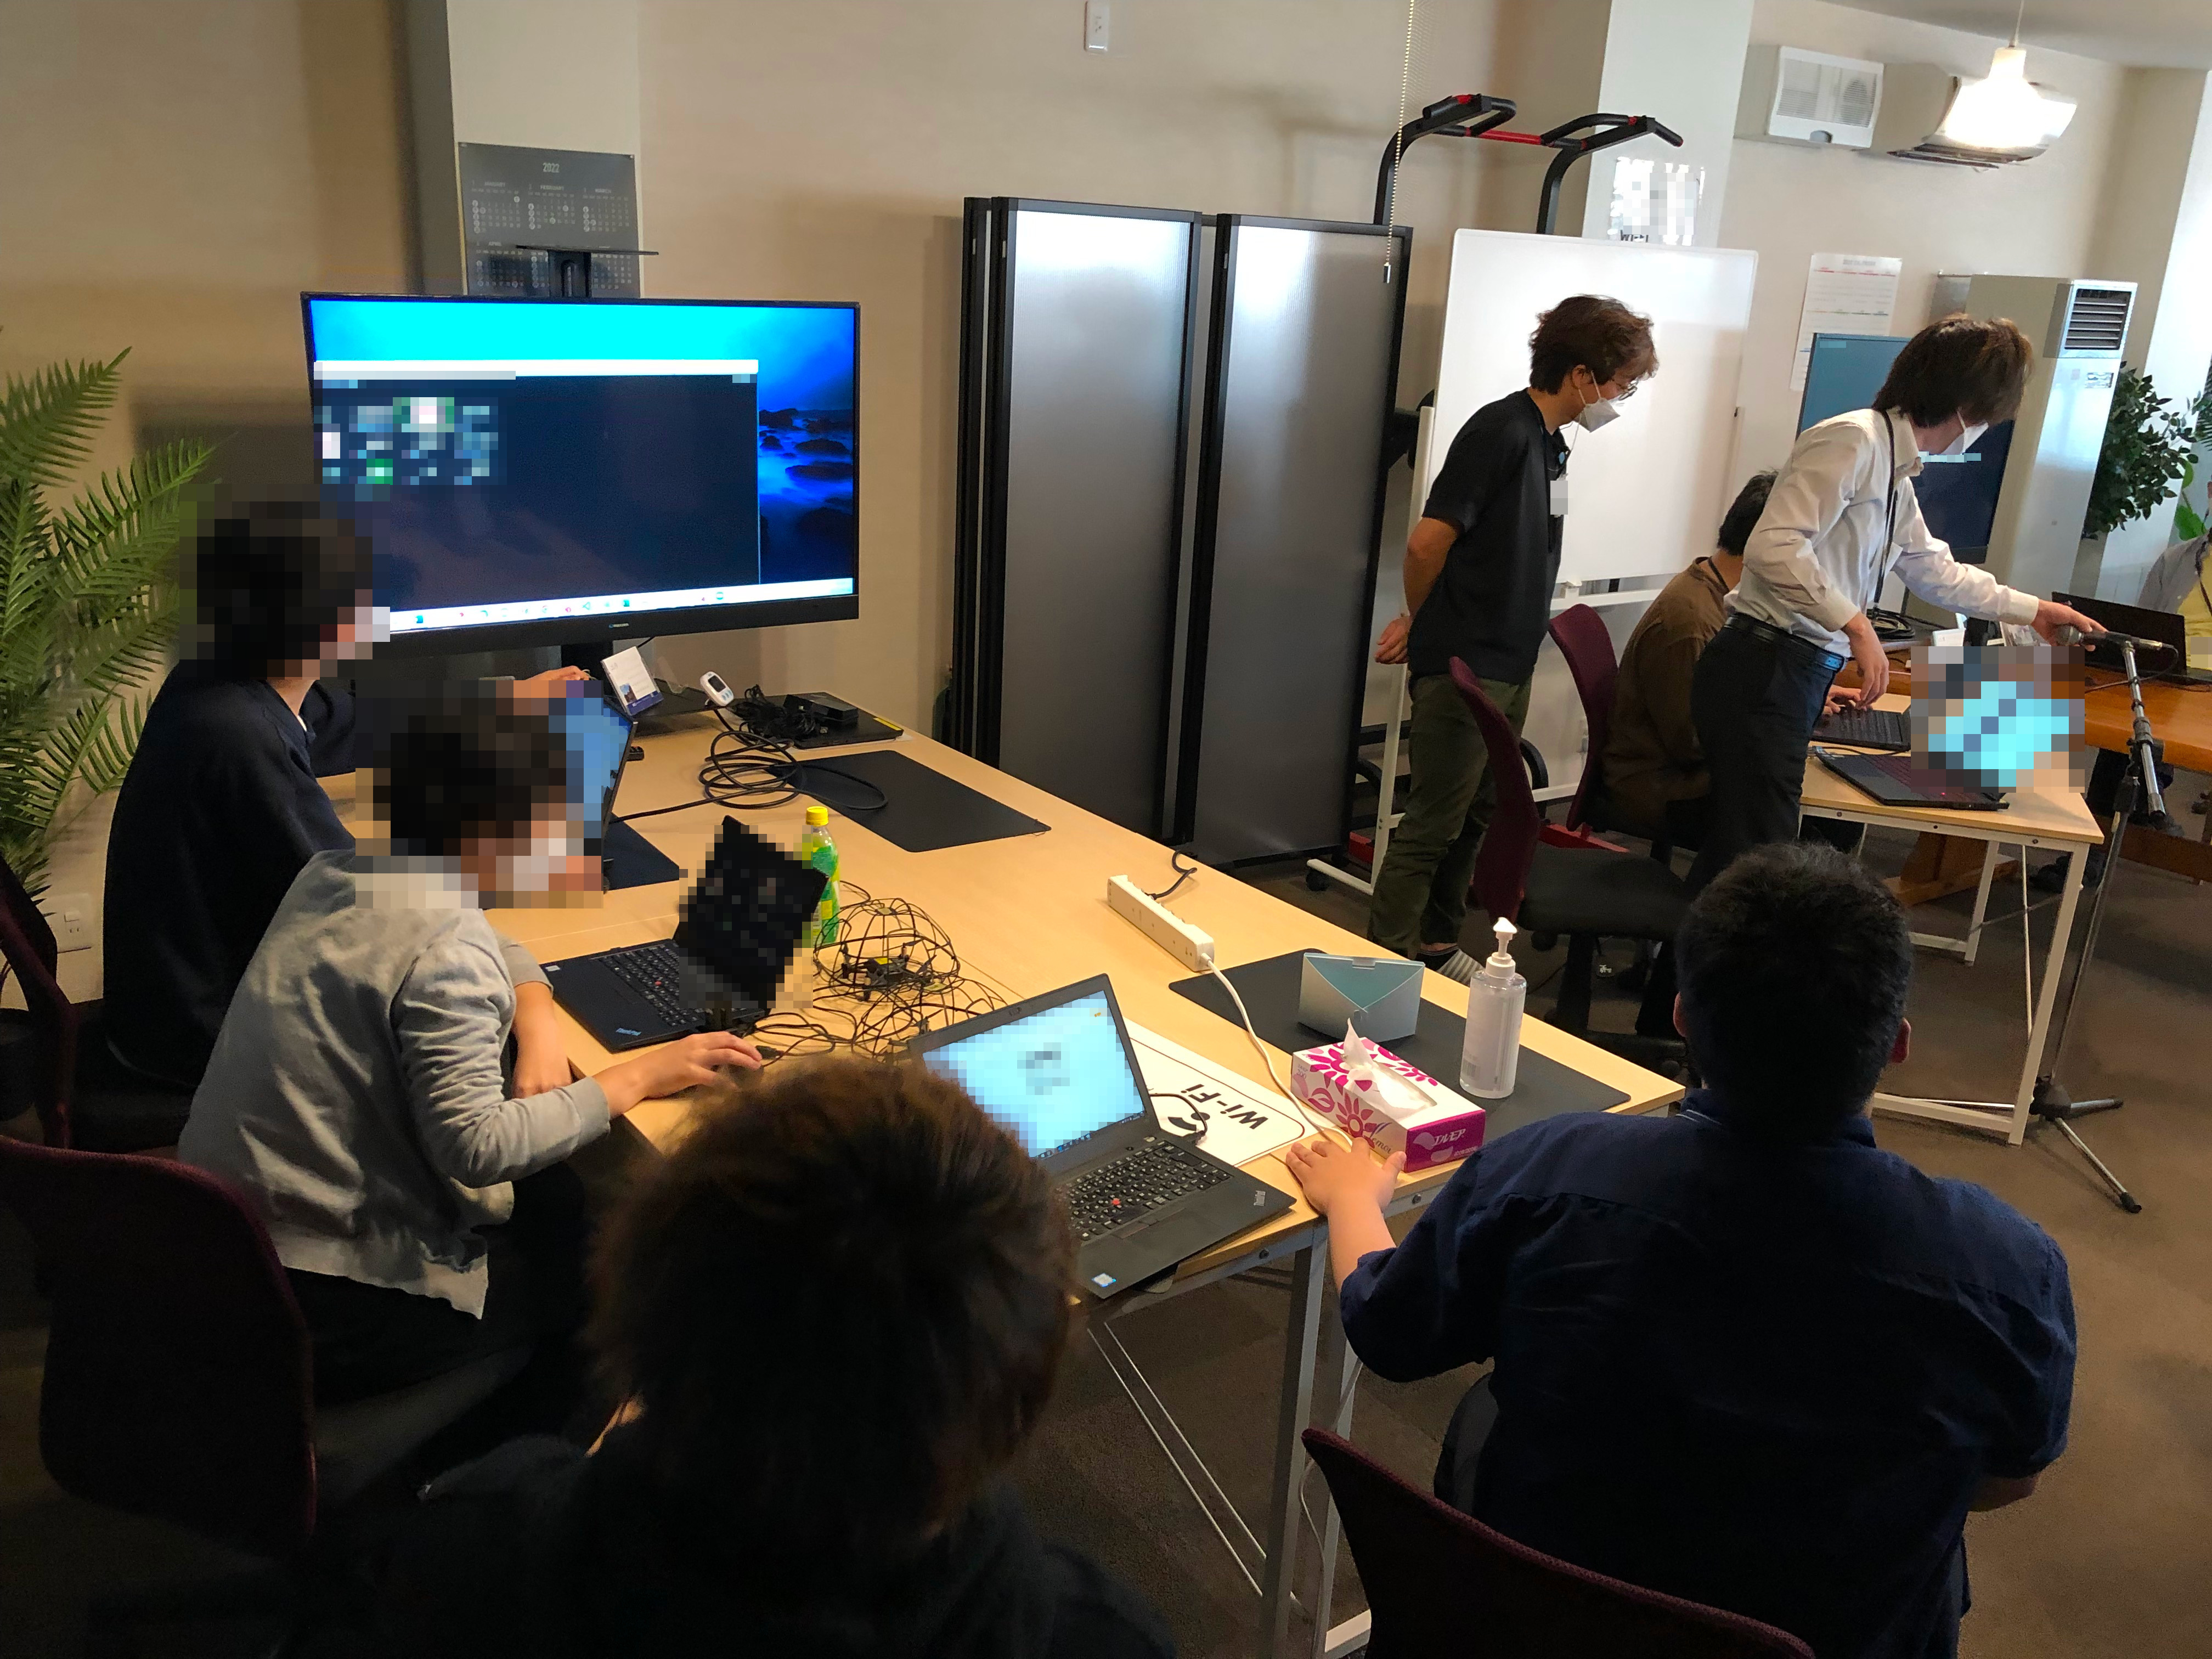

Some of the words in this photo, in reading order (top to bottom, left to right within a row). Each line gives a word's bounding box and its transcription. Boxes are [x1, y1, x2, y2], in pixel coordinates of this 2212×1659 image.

[543, 162, 560, 173] 2022
[1181, 1084, 1269, 1130] Wi-Fi
[1431, 1128, 1466, 1147] エルモア
